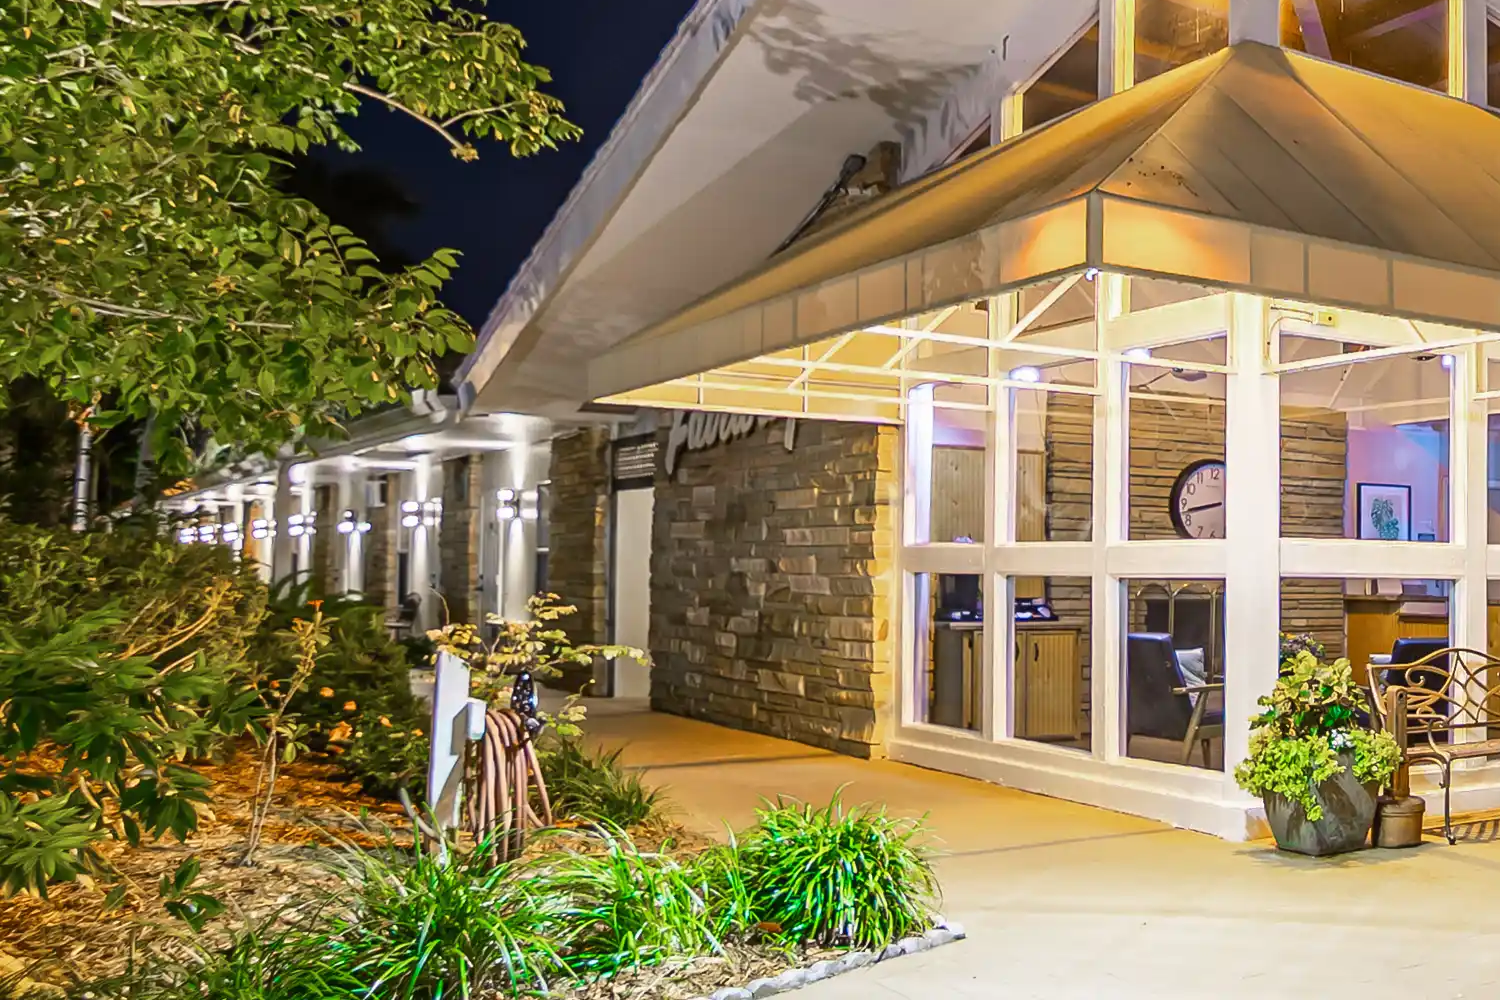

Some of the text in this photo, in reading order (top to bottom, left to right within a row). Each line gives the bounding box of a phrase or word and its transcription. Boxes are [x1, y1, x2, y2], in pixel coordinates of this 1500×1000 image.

[1196, 472, 1204, 484] 11
[1210, 468, 1220, 480] 12
[1186, 482, 1196, 495] 10
[1180, 498, 1187, 509] 9
[1184, 514, 1192, 526] 8
[1197, 525, 1204, 537] 7
